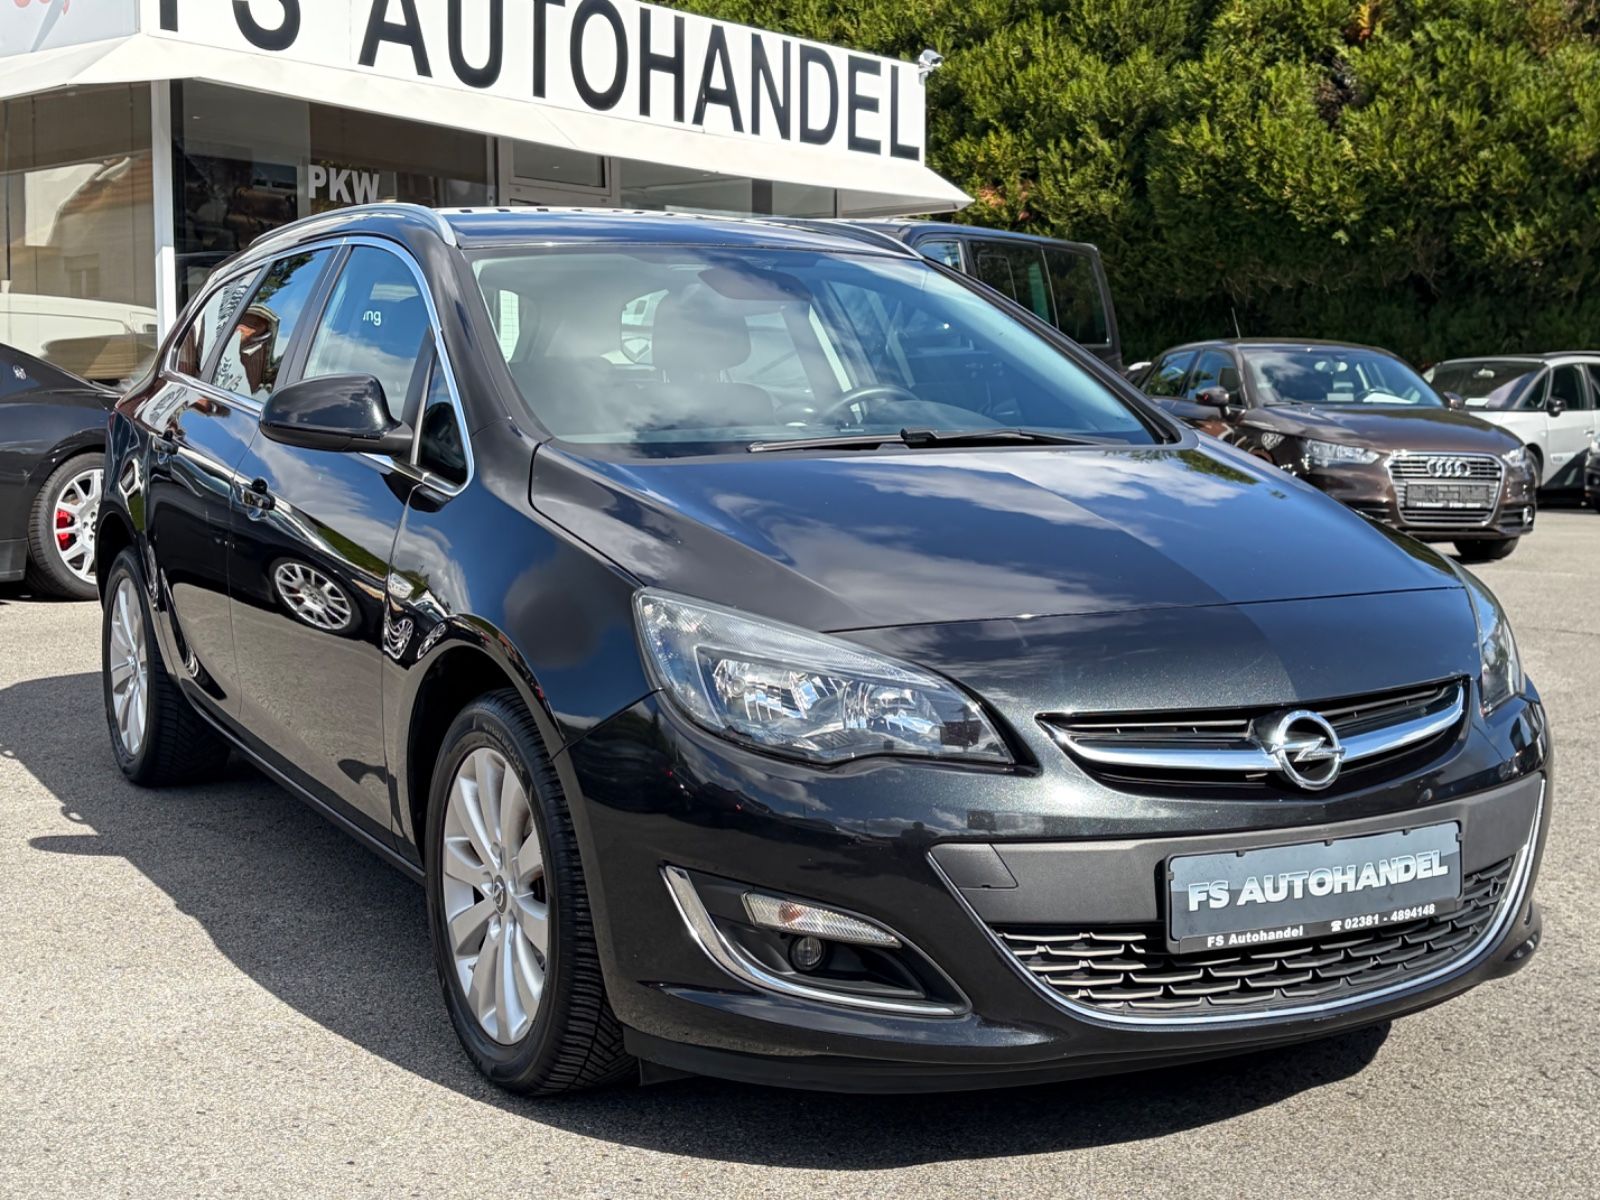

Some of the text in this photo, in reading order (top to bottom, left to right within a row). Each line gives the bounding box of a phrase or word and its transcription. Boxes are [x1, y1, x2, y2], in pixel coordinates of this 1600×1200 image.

[358, 0, 920, 161] AUTOHANDEL
[308, 164, 380, 205] PKW
[1188, 849, 1449, 912] FS AUTOHANDEL
[1207, 934, 1224, 948] FS
[1228, 925, 1304, 945] Autohandel
[1344, 915, 1380, 930] 02381
[1390, 903, 1436, 922] 4894148
